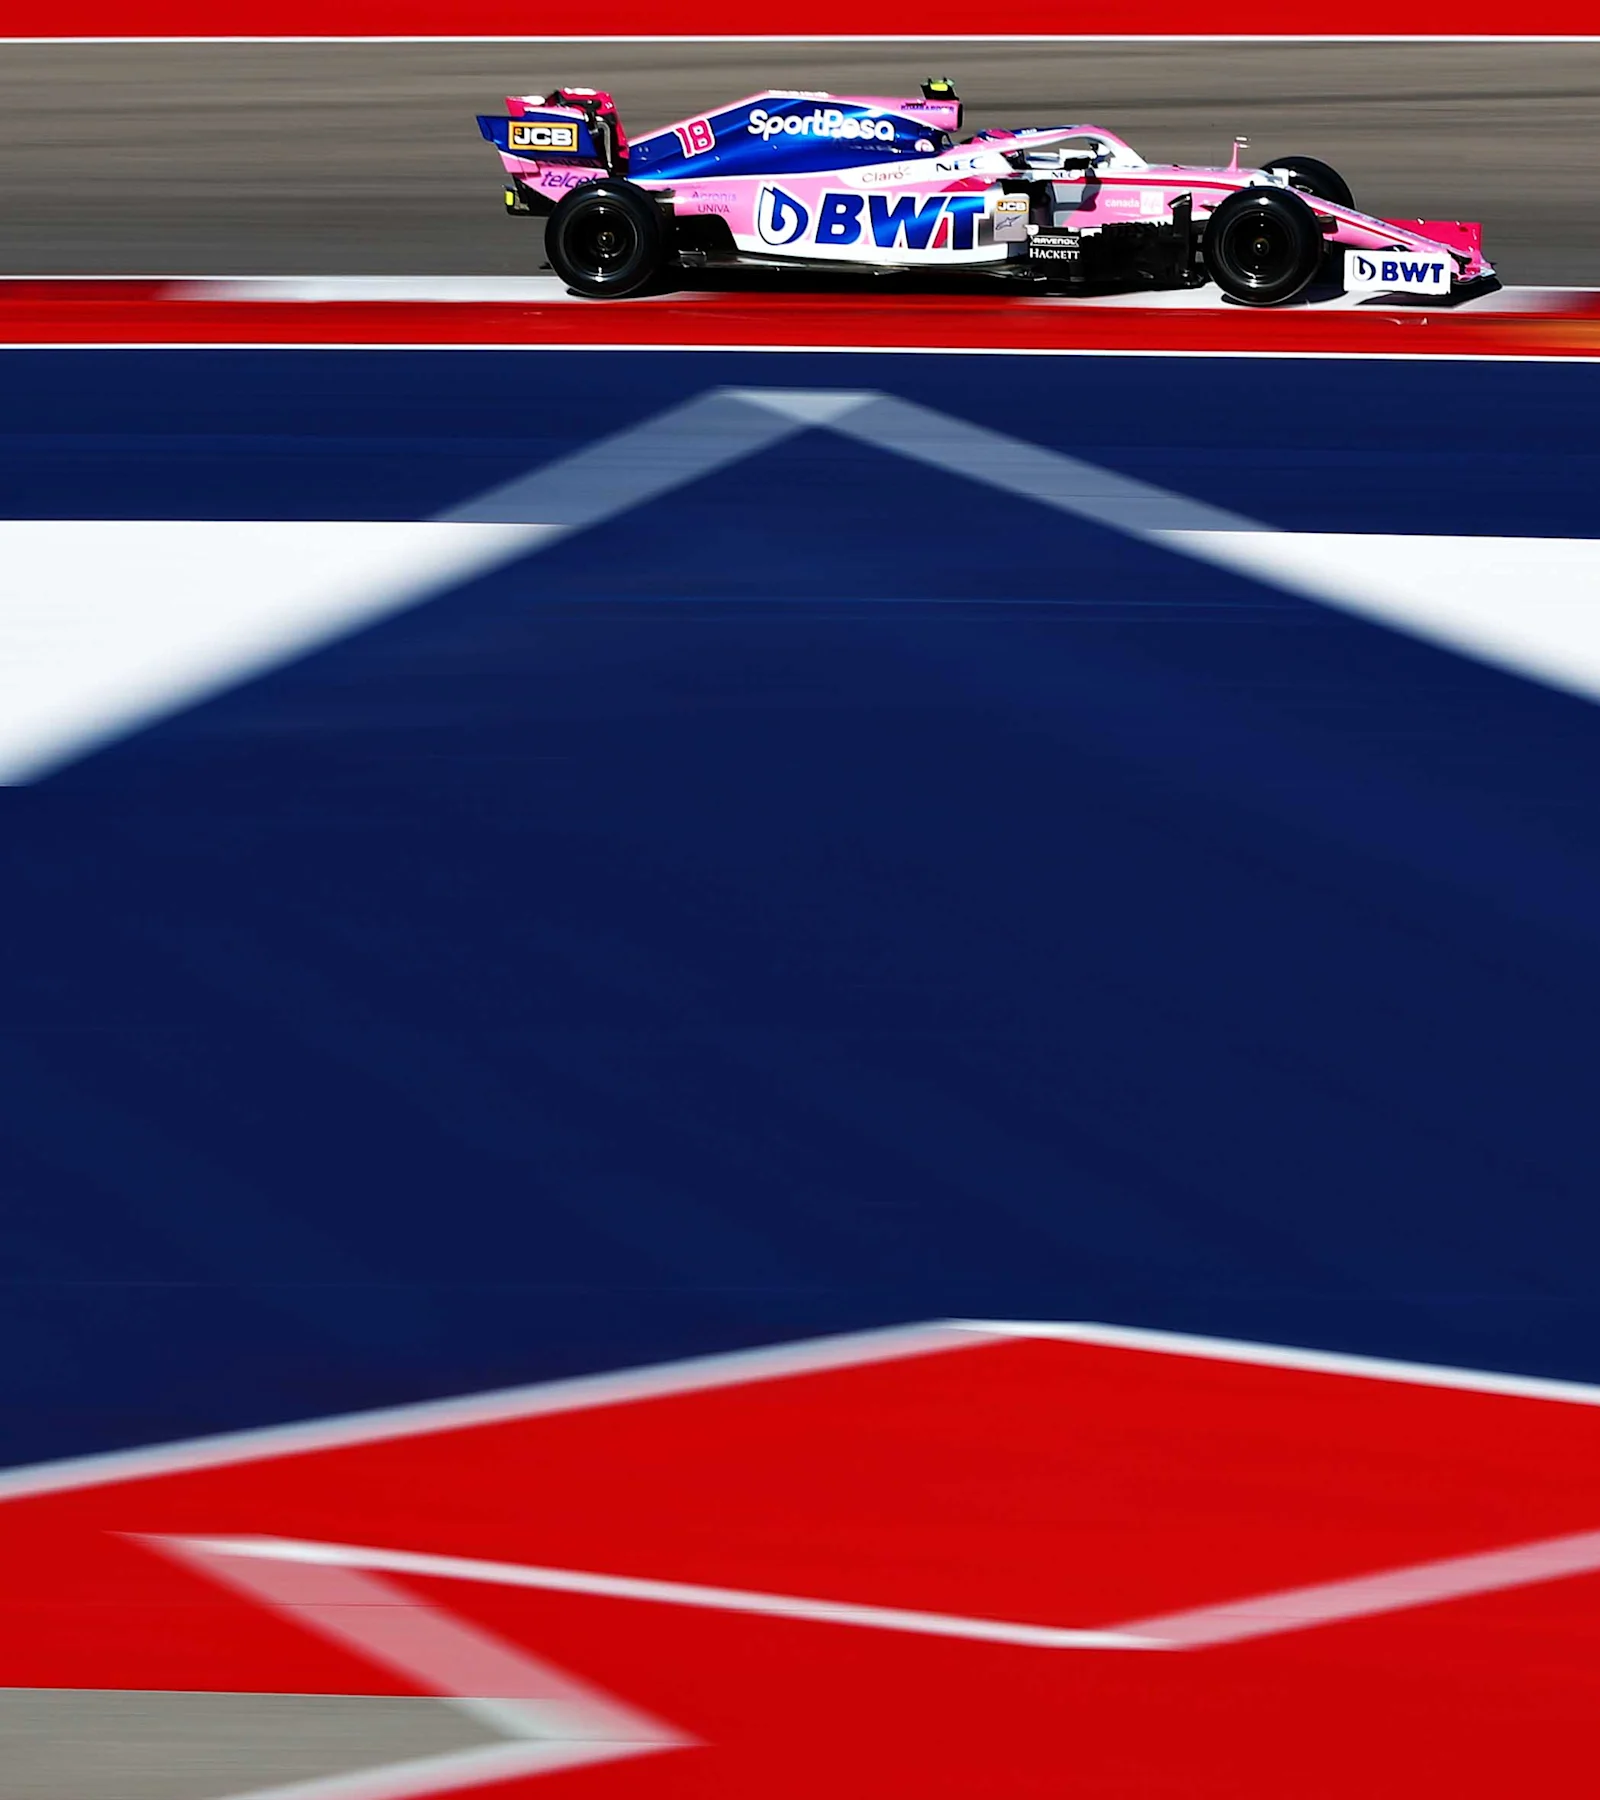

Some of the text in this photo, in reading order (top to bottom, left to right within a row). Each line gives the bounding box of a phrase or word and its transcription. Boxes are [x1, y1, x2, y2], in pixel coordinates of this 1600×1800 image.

[748, 108, 895, 141] SportPesa
[514, 127, 573, 146] JCB
[676, 119, 714, 155] 18
[936, 155, 984, 172] NEC
[862, 170, 904, 183] Claro
[697, 204, 730, 213] UNIVA
[998, 201, 1027, 211] JCB
[815, 193, 985, 250] BWT
[1033, 237, 1077, 245] RAVENOL
[1030, 247, 1080, 259] HACKETT
[1381, 261, 1444, 283] BWT
